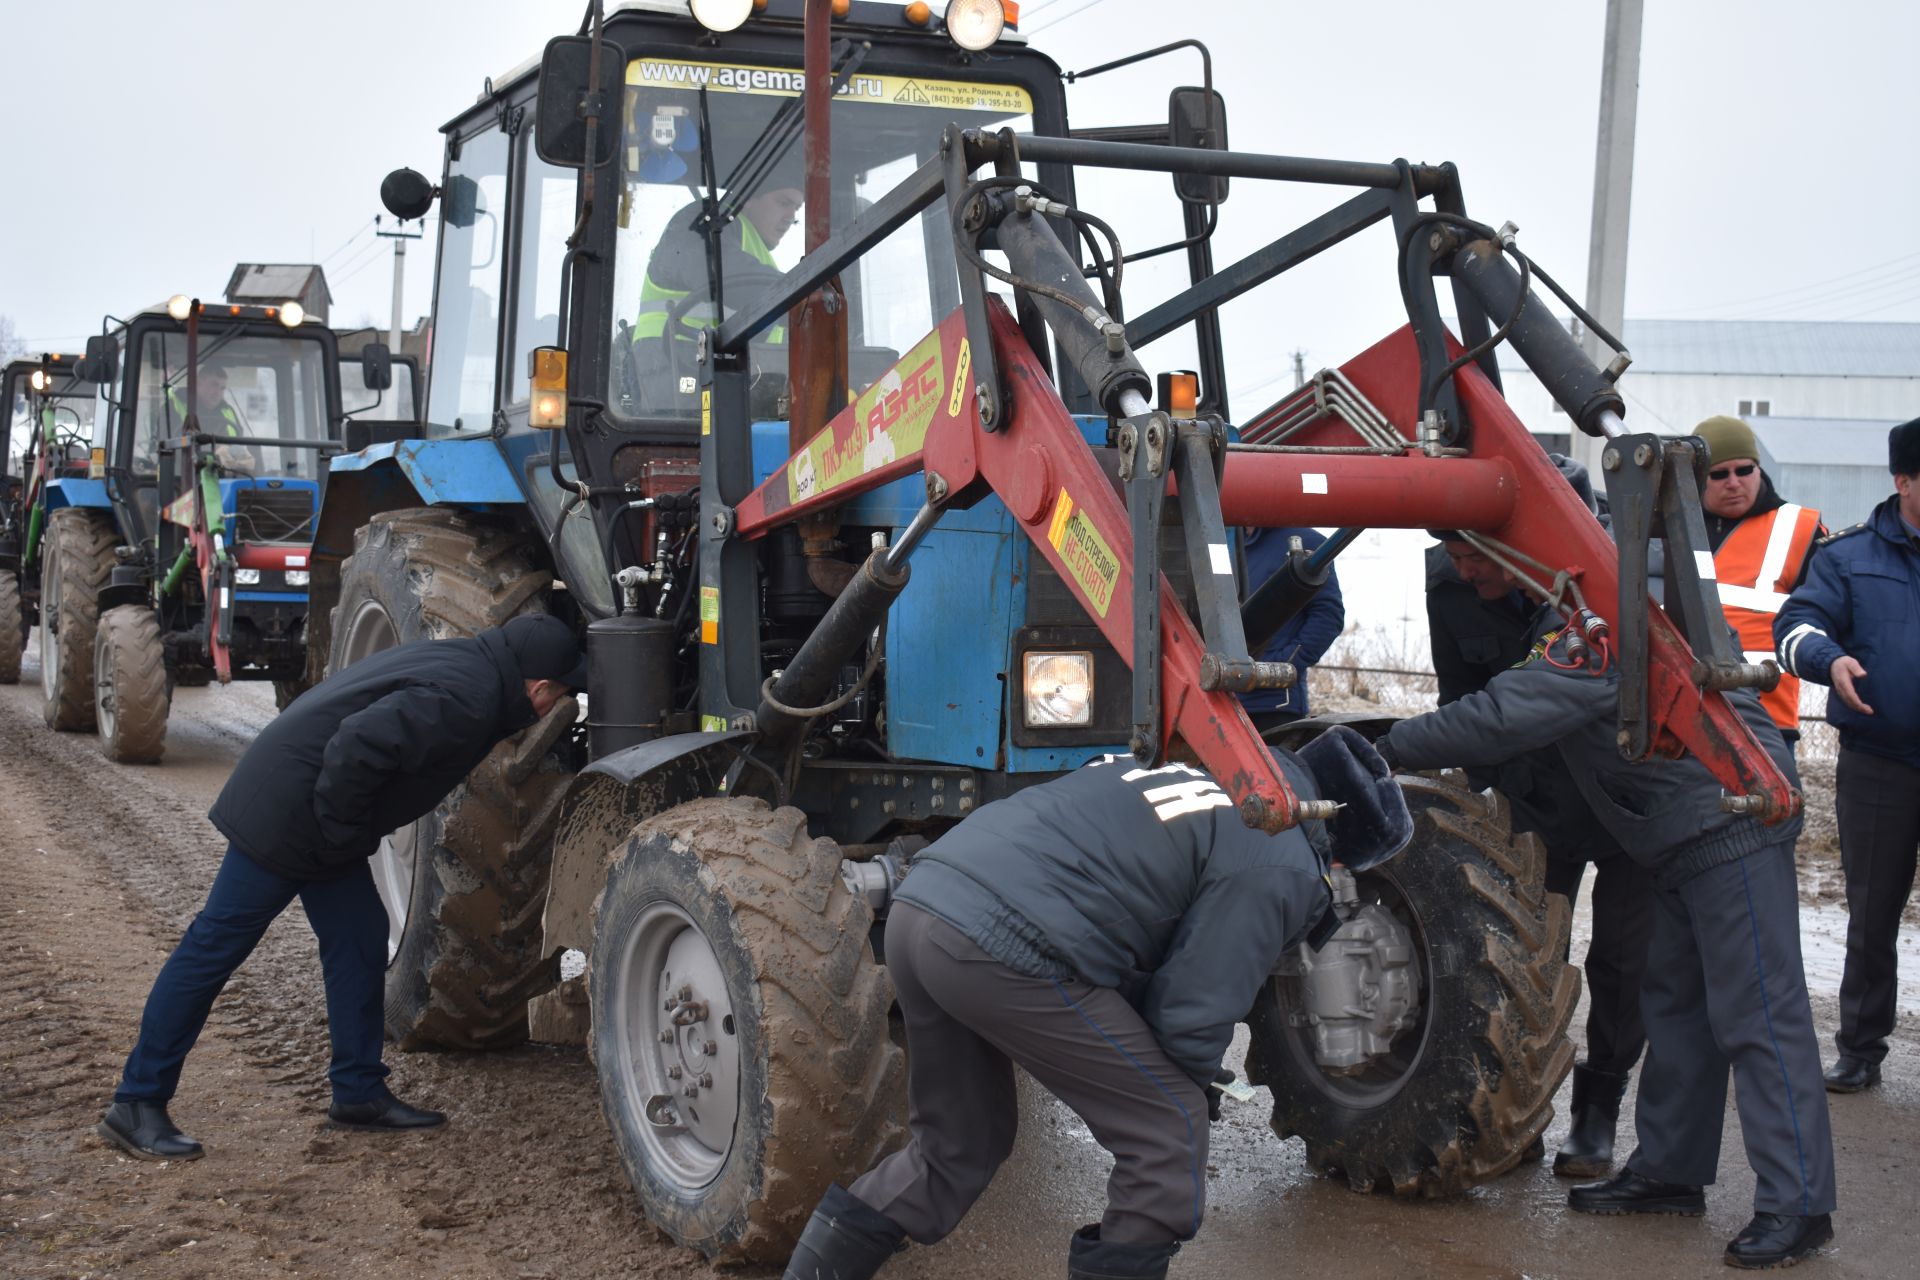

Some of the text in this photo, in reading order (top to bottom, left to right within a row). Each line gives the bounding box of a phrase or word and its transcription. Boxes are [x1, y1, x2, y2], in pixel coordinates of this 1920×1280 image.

[1064, 534, 1106, 606] НЕ СТОЯТЬ
[1071, 516, 1116, 584] ПОД СТРЕЛОЙ
